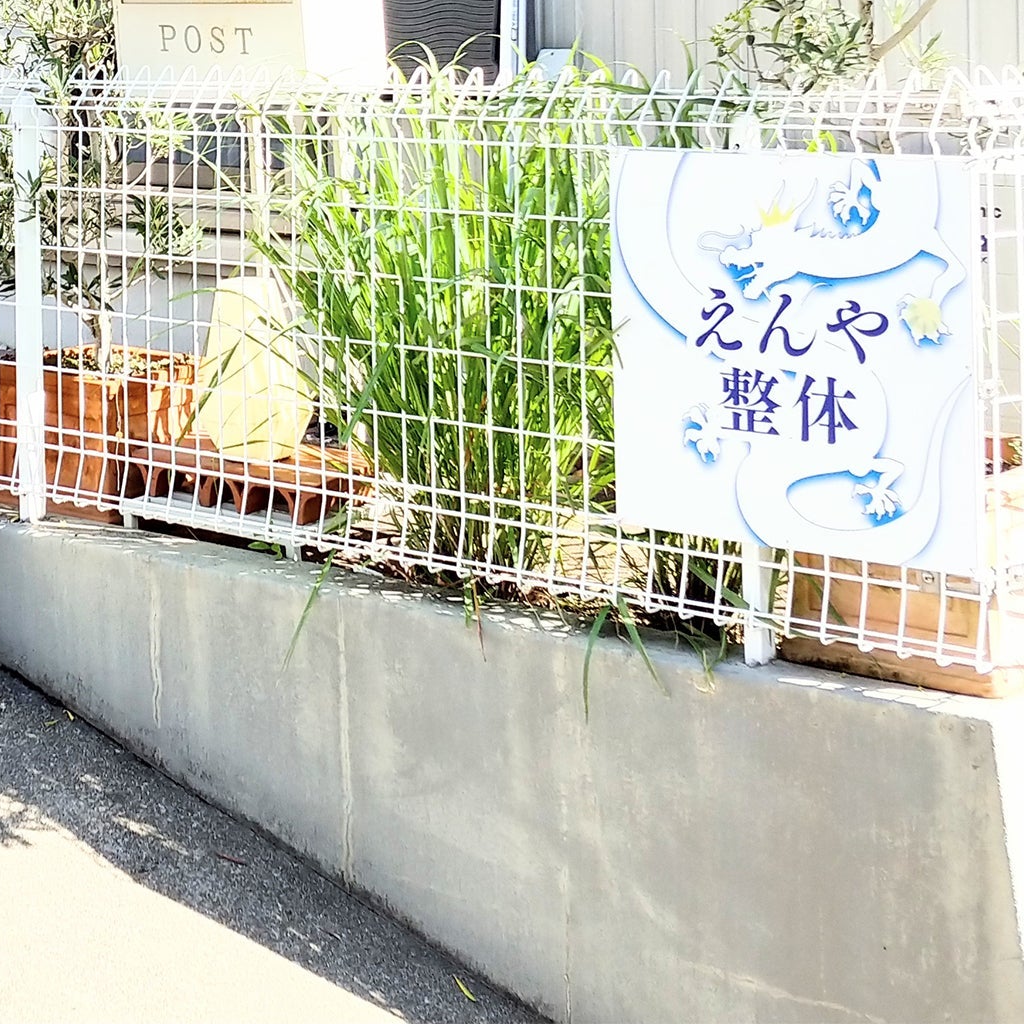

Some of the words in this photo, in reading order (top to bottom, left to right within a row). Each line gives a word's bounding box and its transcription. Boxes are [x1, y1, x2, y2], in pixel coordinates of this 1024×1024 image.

[158, 24, 254, 55] POST
[695, 287, 889, 364] えんや
[720, 366, 859, 445] 整体
